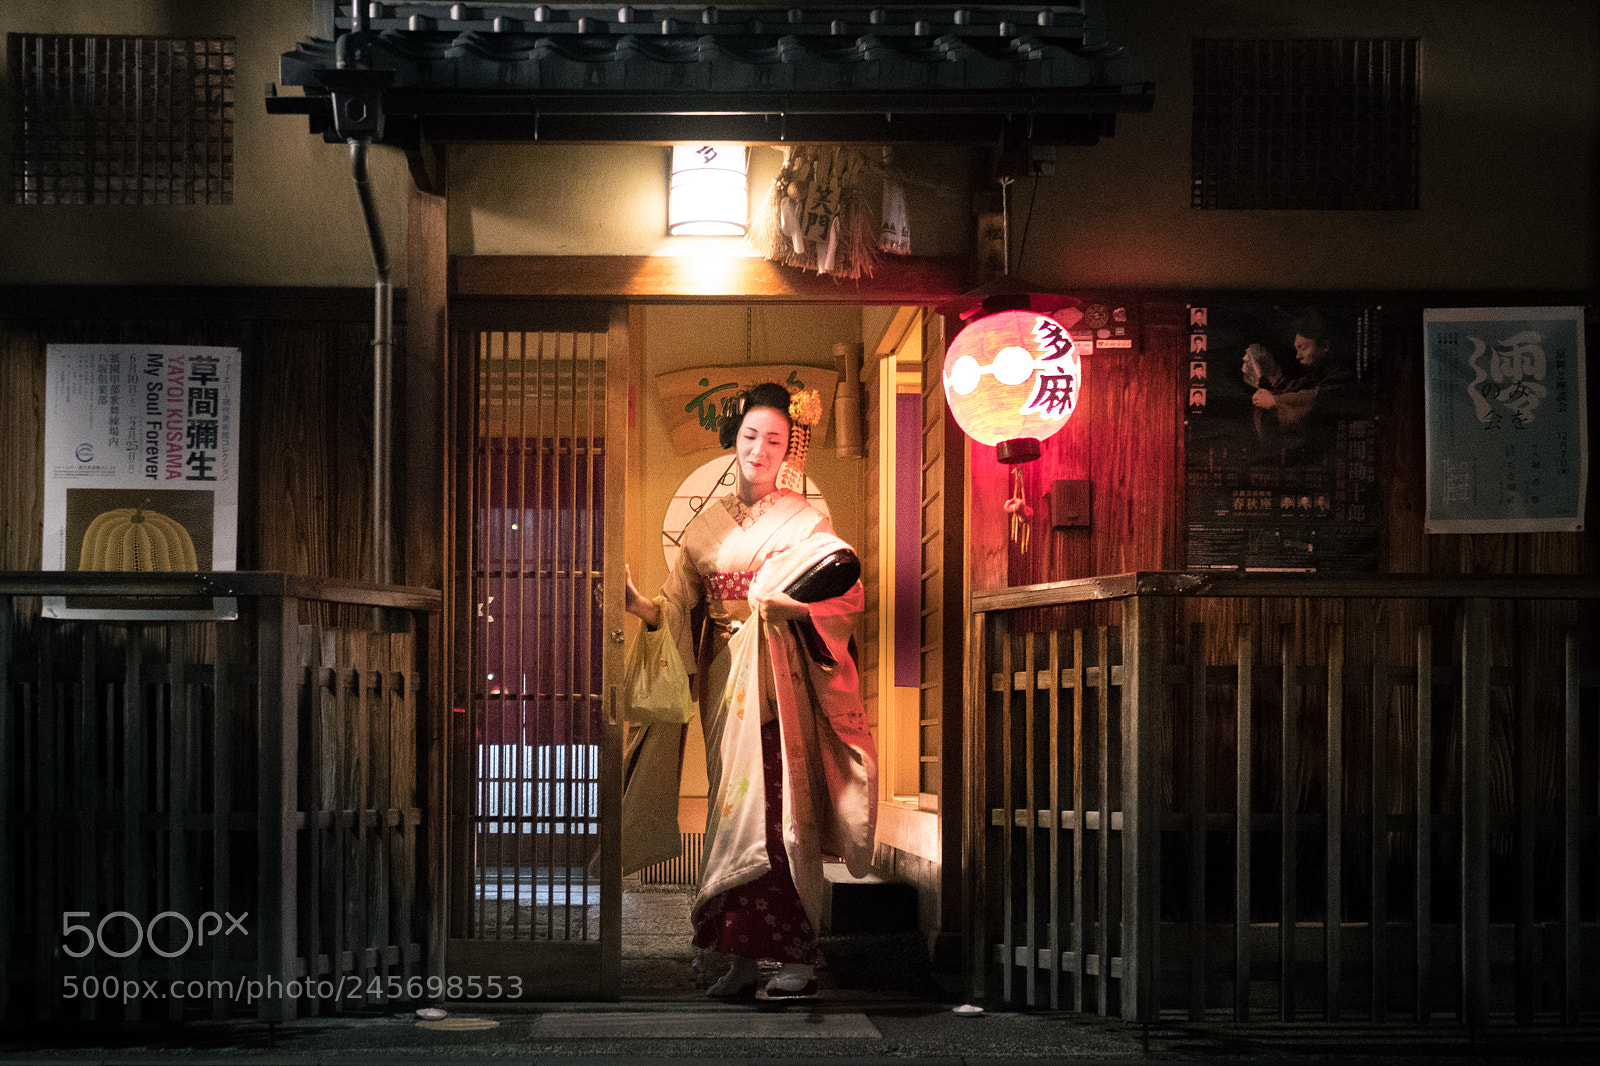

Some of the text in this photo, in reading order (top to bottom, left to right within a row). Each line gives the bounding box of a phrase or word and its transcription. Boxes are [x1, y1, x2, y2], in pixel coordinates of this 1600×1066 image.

[804, 184, 834, 241] 笑門
[143, 353, 164, 481] My Soul Forever
[165, 354, 185, 481] YAYOI KUSAMA
[186, 355, 220, 482] 草間彌生
[1028, 320, 1074, 415] 多麻
